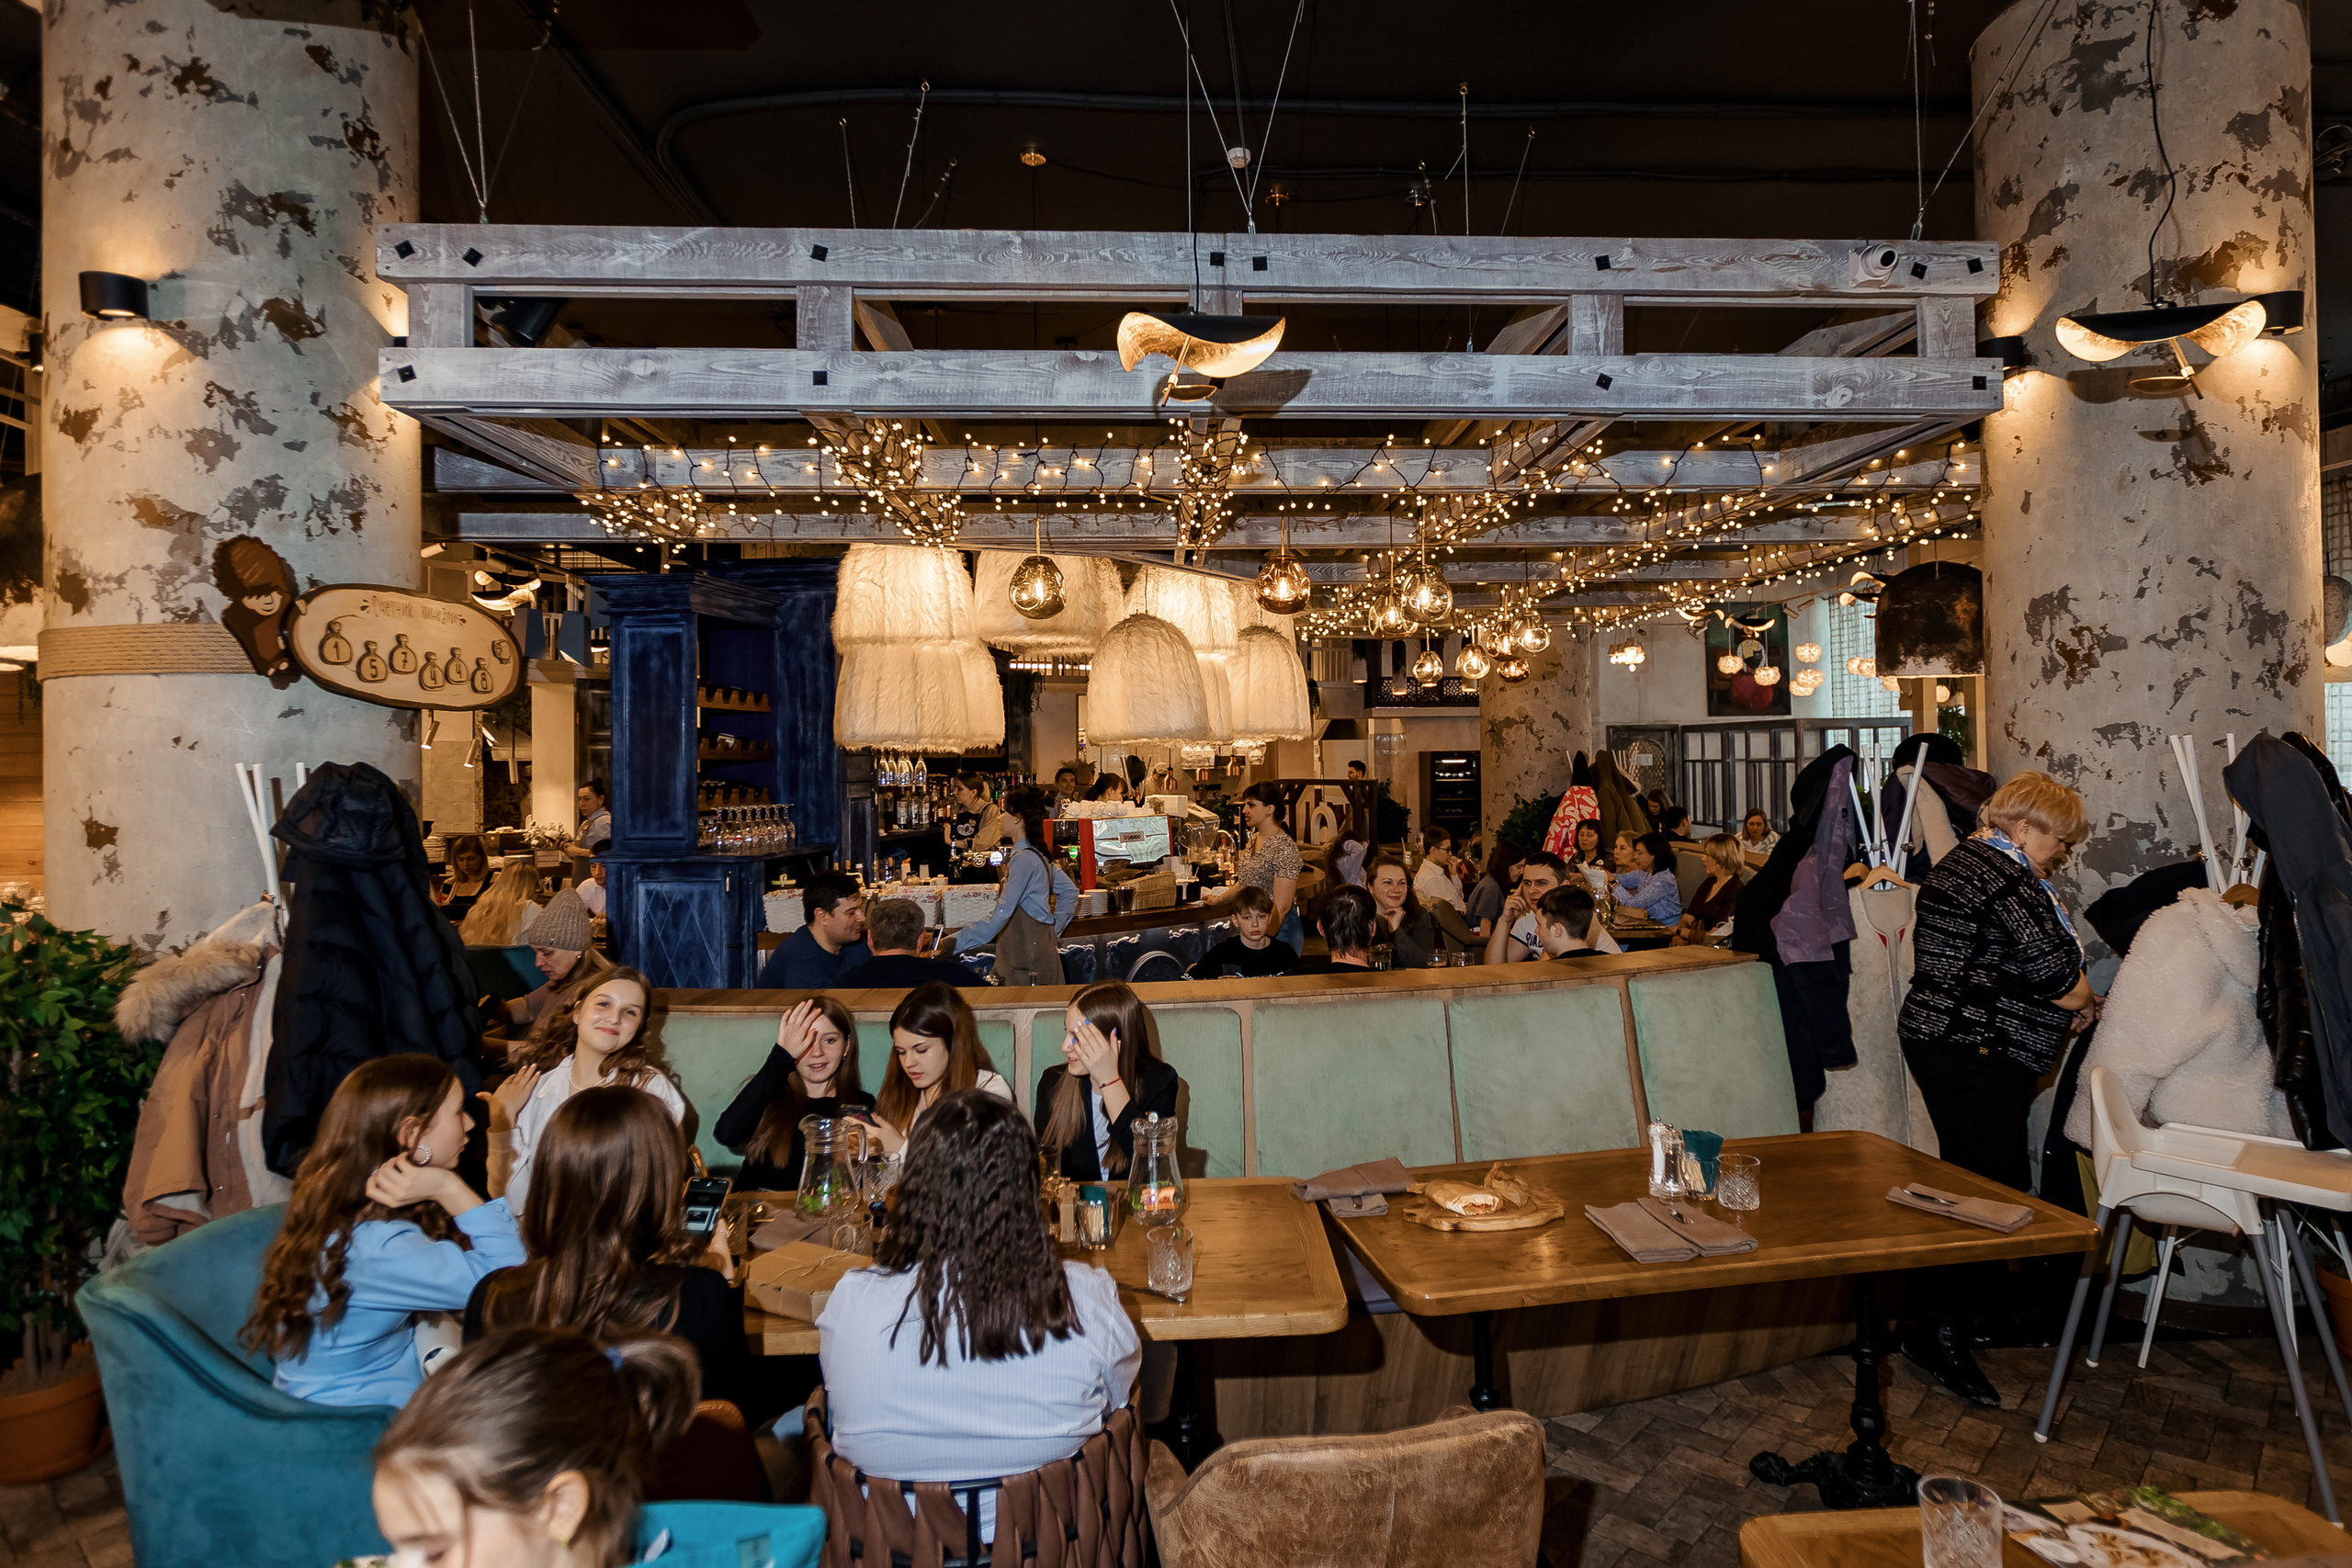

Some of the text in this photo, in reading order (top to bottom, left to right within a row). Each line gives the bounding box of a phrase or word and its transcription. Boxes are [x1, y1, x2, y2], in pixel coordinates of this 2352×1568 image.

[334, 641, 340, 660] 1
[369, 659, 378, 679] 5
[401, 651, 408, 669] 7
[430, 669, 436, 685] 4
[456, 663, 462, 678] 4
